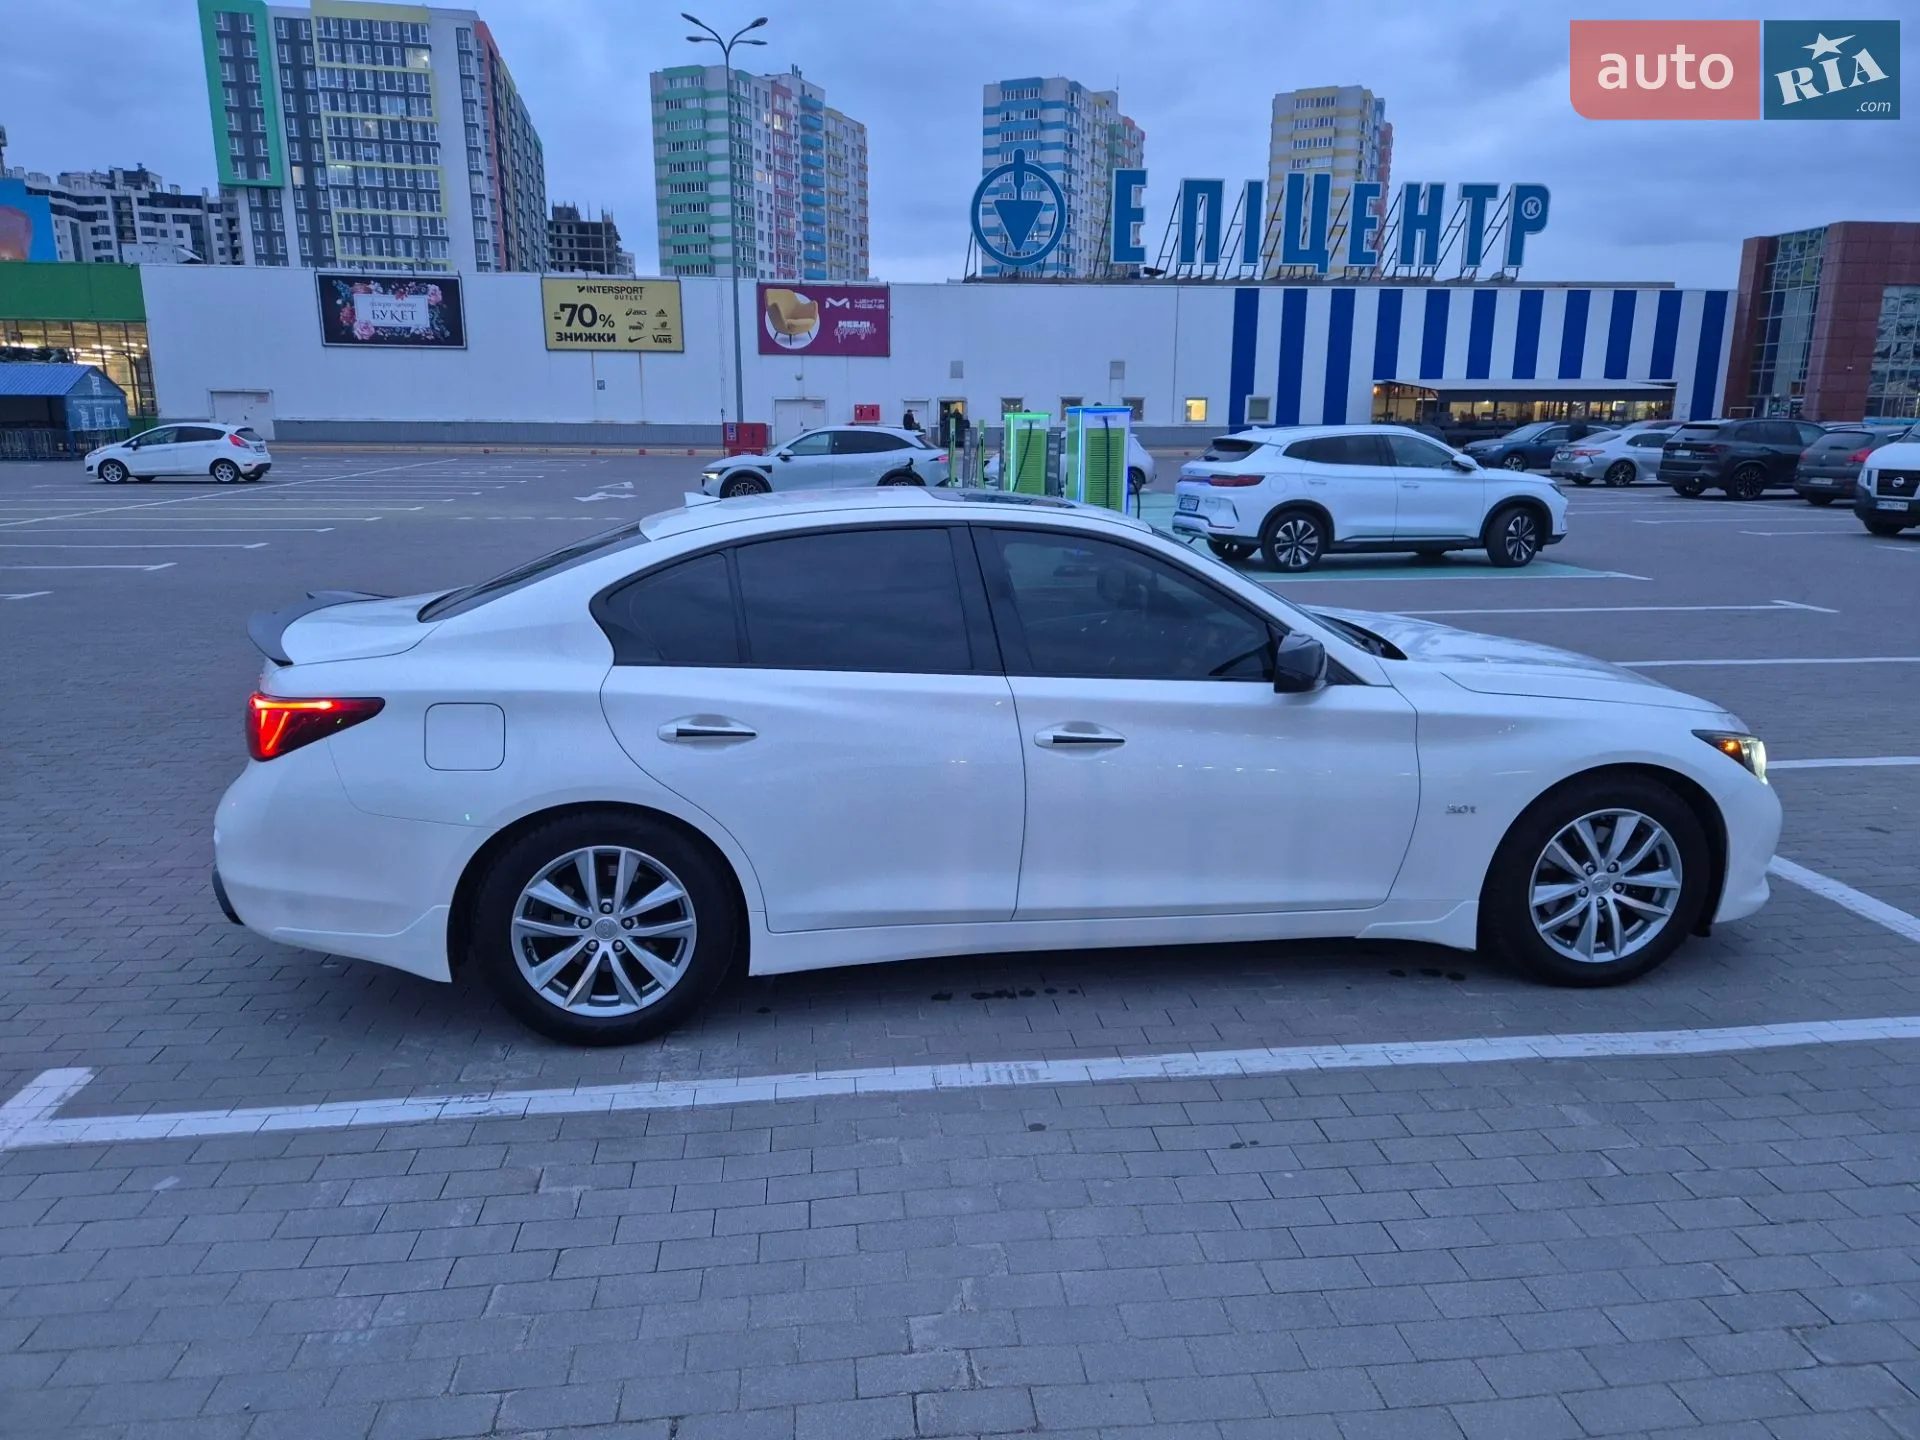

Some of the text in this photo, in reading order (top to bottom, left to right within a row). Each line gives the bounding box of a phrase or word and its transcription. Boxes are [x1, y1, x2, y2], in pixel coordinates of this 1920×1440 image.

[1112, 168, 1550, 274] ЕПІЦЕНТР
[586, 285, 645, 295] INTERSPORT
[371, 309, 418, 322] БУКЕТ
[554, 303, 615, 328] -70%
[555, 332, 617, 343] ЗНИЖКИ
